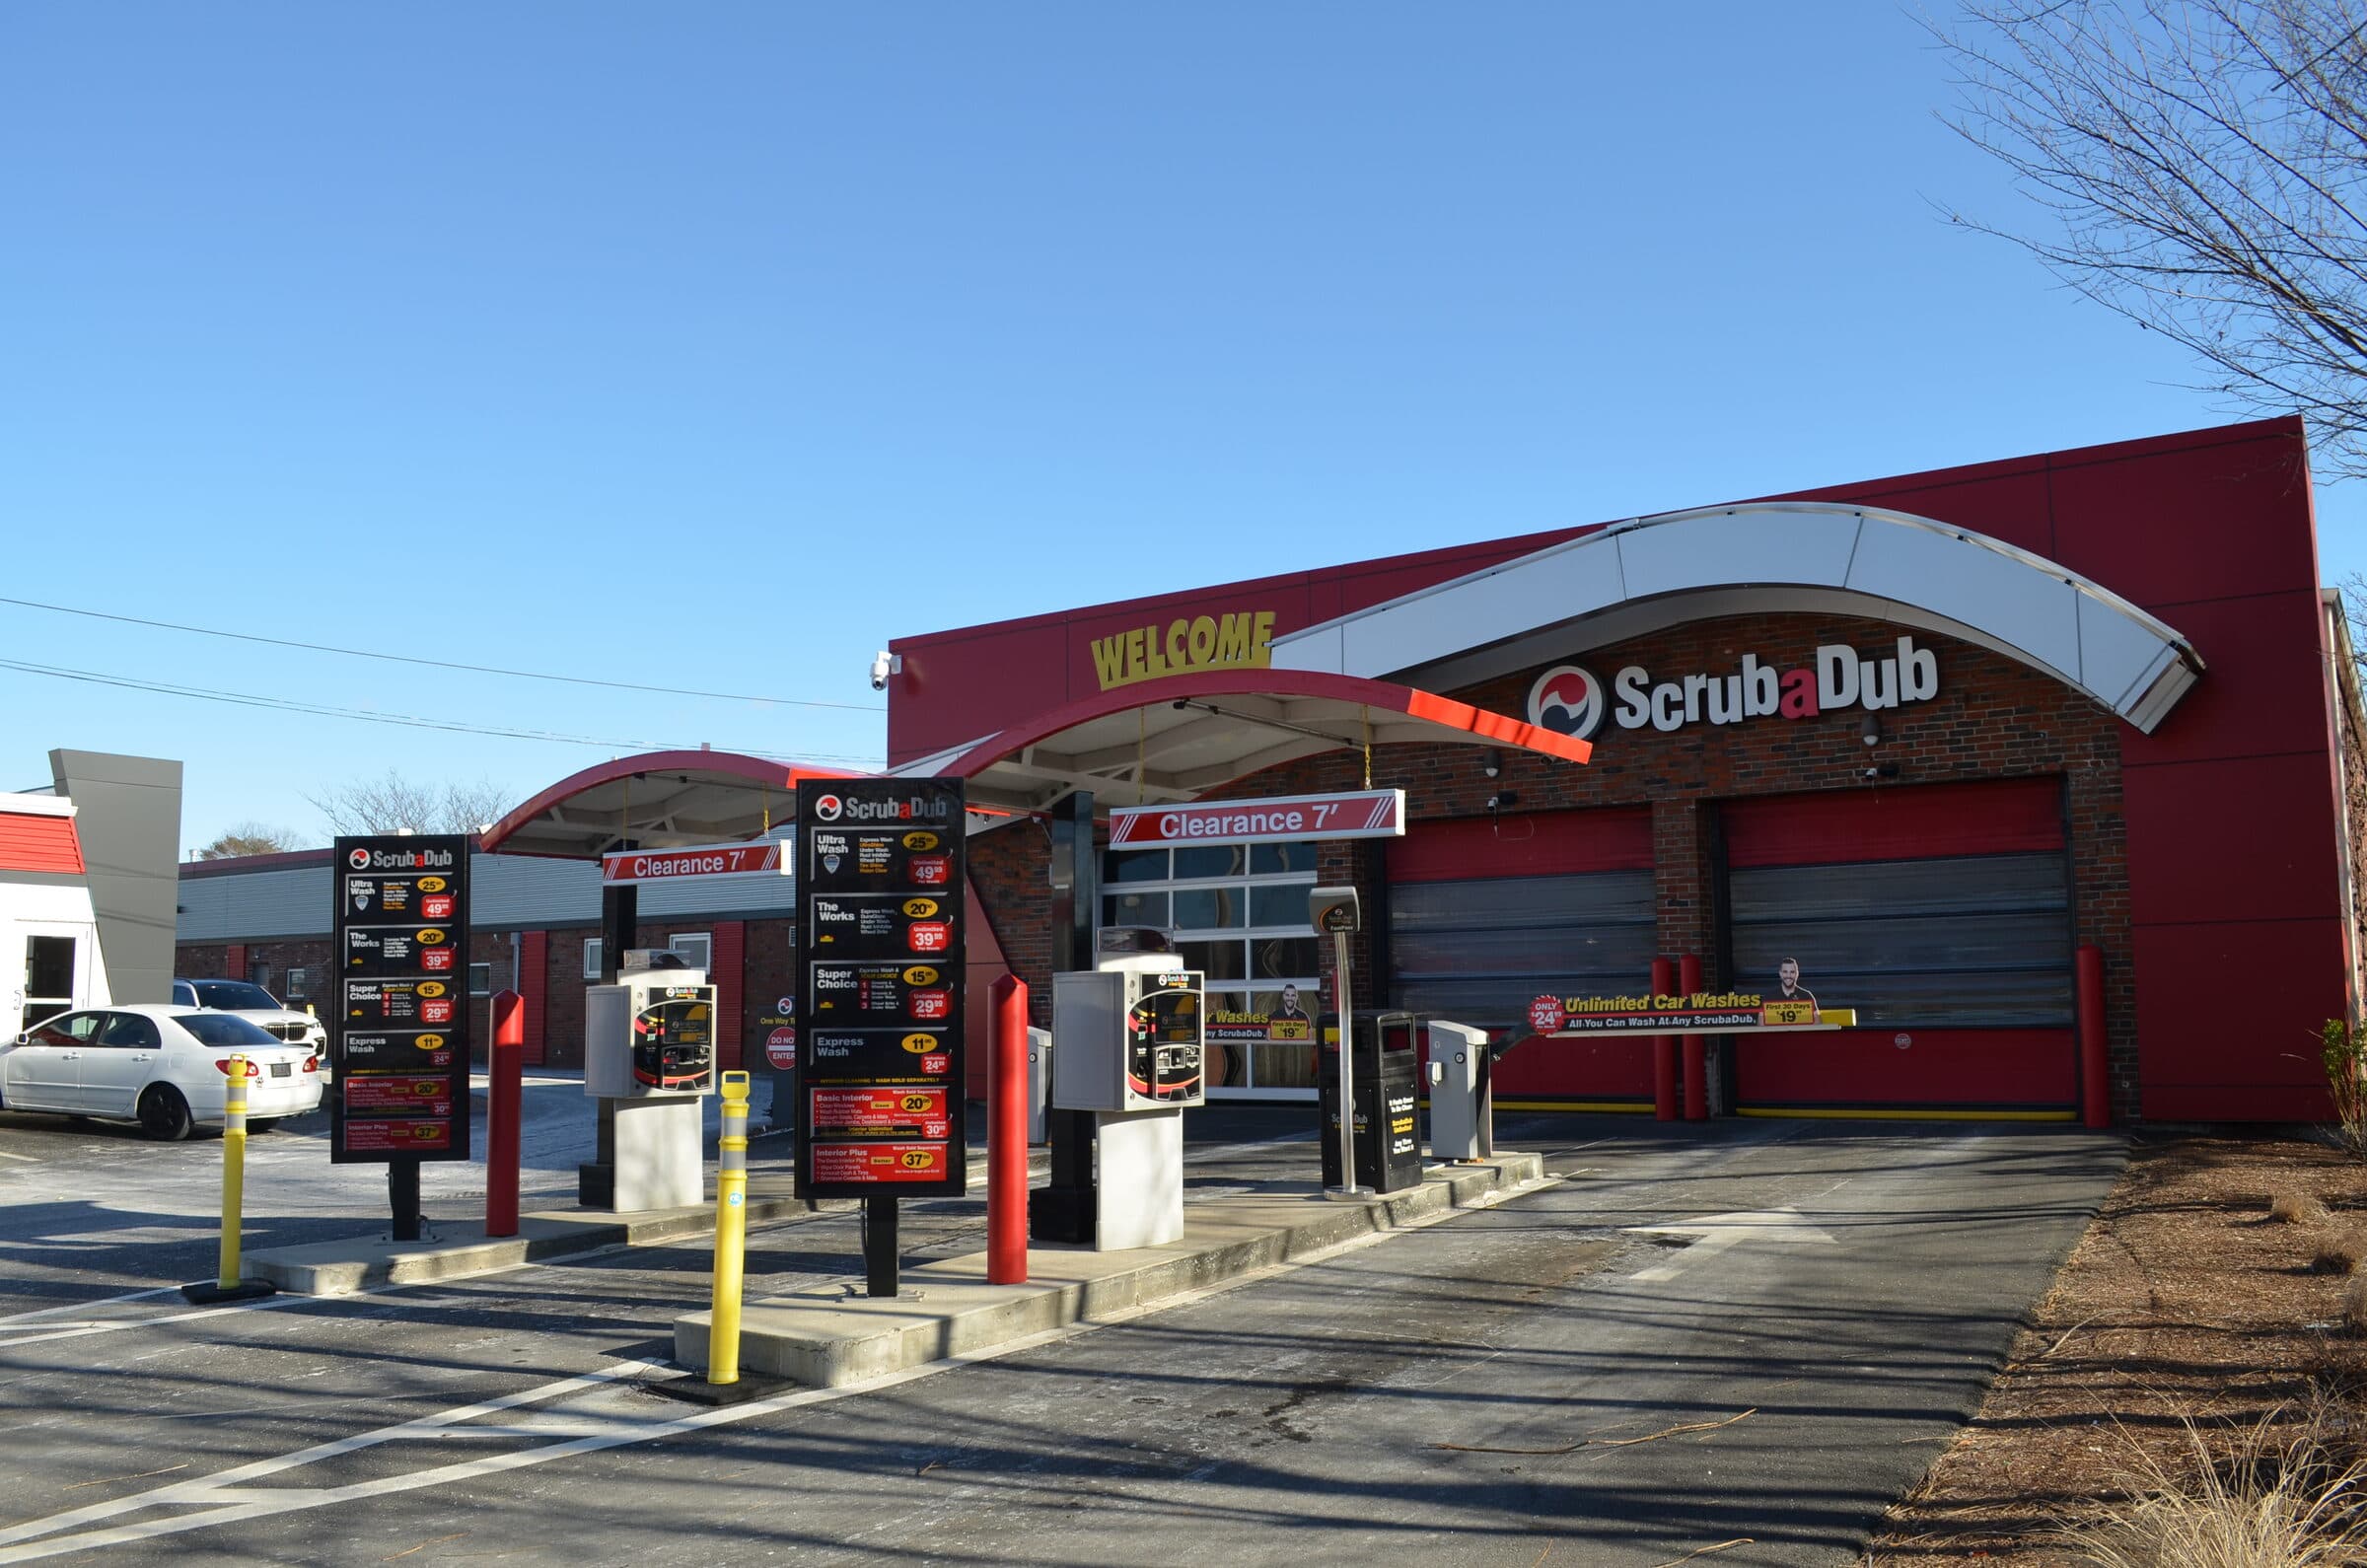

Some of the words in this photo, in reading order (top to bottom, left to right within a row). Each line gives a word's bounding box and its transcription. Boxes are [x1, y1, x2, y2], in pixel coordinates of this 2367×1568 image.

[1091, 610, 1276, 691] WELCOME
[1614, 636, 1938, 732] ScrubaDub
[846, 796, 947, 820] ScrubaDub
[1159, 812, 1303, 838] Clearance
[1312, 804, 1338, 828] 7'
[817, 834, 846, 844] Ultra
[817, 844, 849, 854] Wash
[373, 849, 453, 868] ScrubaDub
[634, 857, 724, 877] Clearance
[729, 850, 746, 870] 7'
[350, 880, 373, 888] Ultra
[817, 902, 839, 911] The
[820, 912, 855, 921] Works
[817, 968, 853, 980] Super
[350, 984, 377, 993] Super
[817, 979, 858, 989] Choice
[1565, 995, 1650, 1012] Unlimited
[1654, 994, 1686, 1010] Car
[1690, 992, 1761, 1008] Washes
[775, 1017, 789, 1026] Way
[1216, 1010, 1269, 1023] Washes
[1584, 1019, 1603, 1028] You
[1606, 1018, 1626, 1026] Can
[1628, 1017, 1655, 1026] Wash
[1672, 1017, 1691, 1026] Any
[349, 1037, 386, 1046] Express
[817, 1037, 864, 1048] Express
[817, 1047, 849, 1056] Wash
[1331, 1113, 1368, 1124] ScDub
